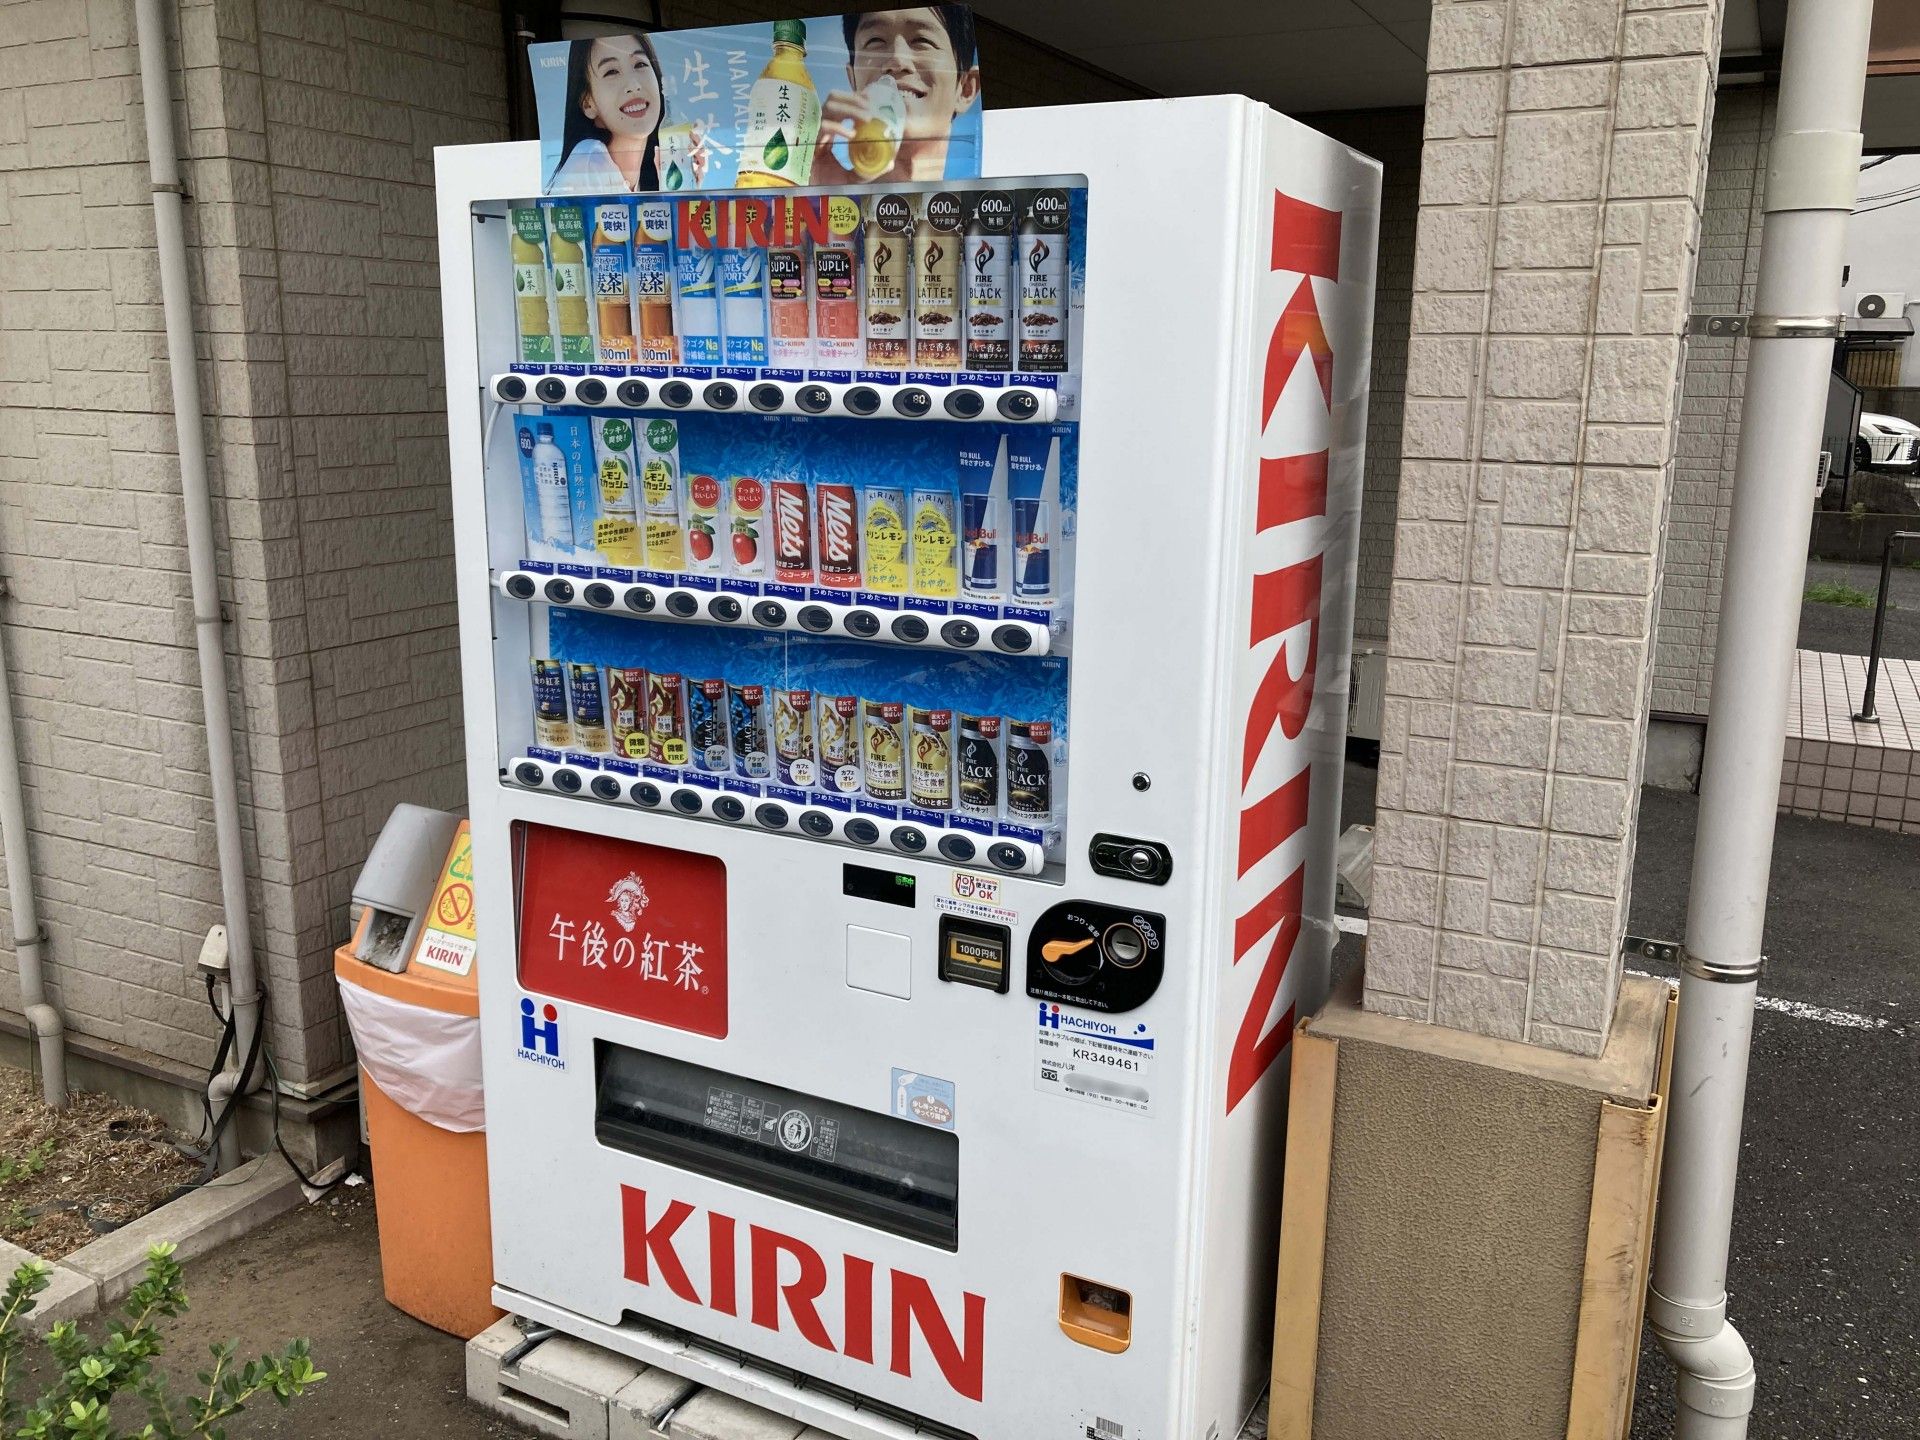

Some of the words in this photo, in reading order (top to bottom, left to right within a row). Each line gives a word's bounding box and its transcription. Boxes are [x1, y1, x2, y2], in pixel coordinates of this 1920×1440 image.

[540, 56, 567, 68] KIRIN
[776, 85, 791, 122] 生茶
[879, 202, 907, 216] 600ml
[930, 201, 959, 214] 600ml
[982, 199, 1011, 212] 600ml
[1036, 197, 1067, 211] 600ml
[601, 211, 628, 219] のどごし
[643, 210, 670, 218] のどごし
[1043, 215, 1059, 224] 無糖
[519, 222, 542, 230] 最高級
[559, 221, 582, 230] 最高級
[604, 221, 626, 231] 爽快!
[645, 219, 668, 230] 爽快!
[677, 195, 830, 249] KIRIN
[988, 217, 1003, 225] 無糖
[771, 261, 799, 273] SUPLI+
[818, 260, 849, 272] SUPLI+
[526, 269, 536, 290] 生茶
[565, 269, 574, 290] 生茶
[1029, 274, 1047, 282] FIRE
[867, 288, 895, 299] LATTE
[918, 288, 946, 298] LATTE
[969, 288, 1001, 299] BLACK
[1022, 287, 1057, 298] BLACK
[706, 338, 718, 350] Na
[751, 339, 764, 351] Na
[604, 425, 628, 435] スッキリ
[647, 426, 674, 436] スッキリ
[608, 435, 627, 444] 爽快!
[653, 436, 672, 445] 爽快!
[969, 452, 981, 460] BULL
[602, 472, 621, 480] レモン
[645, 473, 665, 481] レモン
[737, 494, 761, 502] おいしい
[868, 492, 895, 501] KIRIN
[917, 495, 944, 504] KIRIN
[1225, 187, 1343, 1118] KIRIN
[630, 738, 645, 746] 微糖
[668, 744, 683, 752] 微糖
[871, 754, 886, 762] FIRE
[916, 762, 933, 770] FIRE
[1008, 769, 1046, 785] BLACK
[976, 882, 997, 891] 使えます
[979, 890, 993, 900] OK
[426, 945, 463, 966] KIRIN
[548, 912, 705, 991] 午後の紅茶
[959, 944, 997, 960] 1000円札
[1061, 1015, 1116, 1034] HACHIYOH
[518, 1048, 565, 1070] HACHIYOH
[1073, 1048, 1139, 1071] KR349461
[621, 1184, 986, 1402] KIRIN
